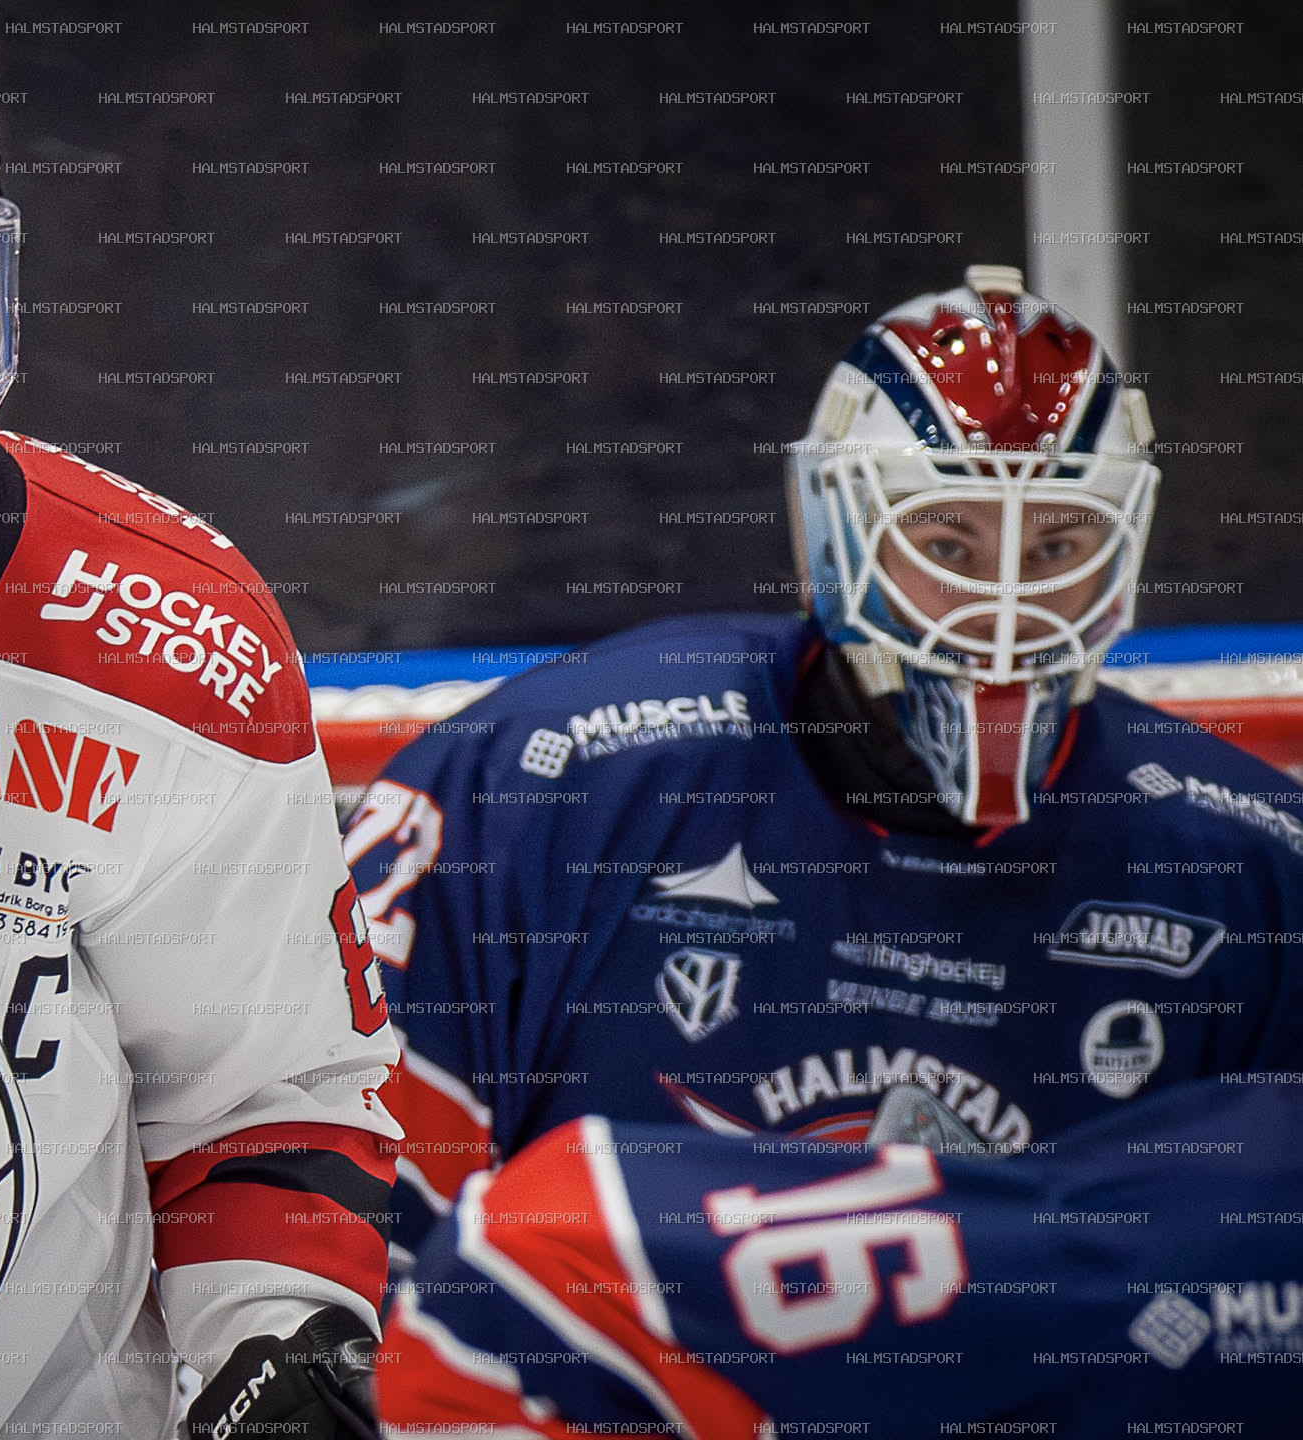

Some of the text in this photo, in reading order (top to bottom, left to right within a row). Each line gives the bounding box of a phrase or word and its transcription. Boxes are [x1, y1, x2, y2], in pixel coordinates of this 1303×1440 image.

[40, 549, 283, 684] HOCKEY
[96, 608, 264, 718] STORE
[569, 690, 752, 746] MUSCLE
[12, 917, 51, 938] 584
[25, 897, 54, 917] Borg
[1081, 910, 1195, 965] JONAB
[3, 954, 70, 1080] C
[753, 1045, 1032, 1146] HALMSTAD
[702, 1144, 970, 1357] 16
